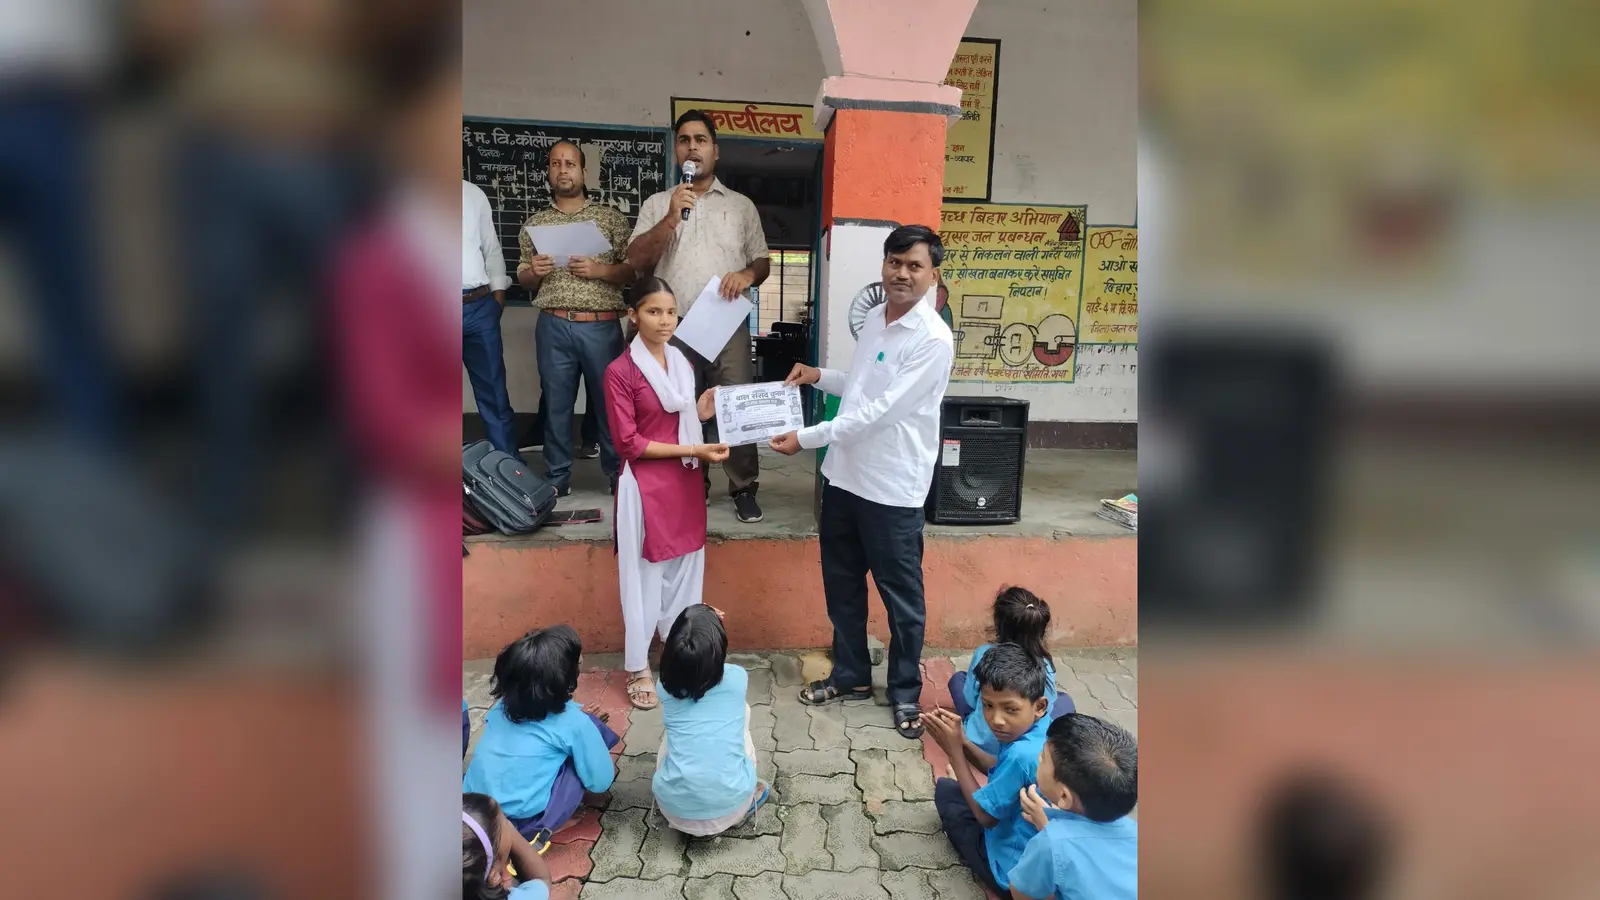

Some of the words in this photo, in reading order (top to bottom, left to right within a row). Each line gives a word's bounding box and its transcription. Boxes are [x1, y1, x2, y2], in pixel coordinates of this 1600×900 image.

[703, 104, 804, 136] कार्यालय
[971, 231, 996, 243] जल
[959, 244, 972, 262] से
[1013, 246, 1041, 261] वाली
